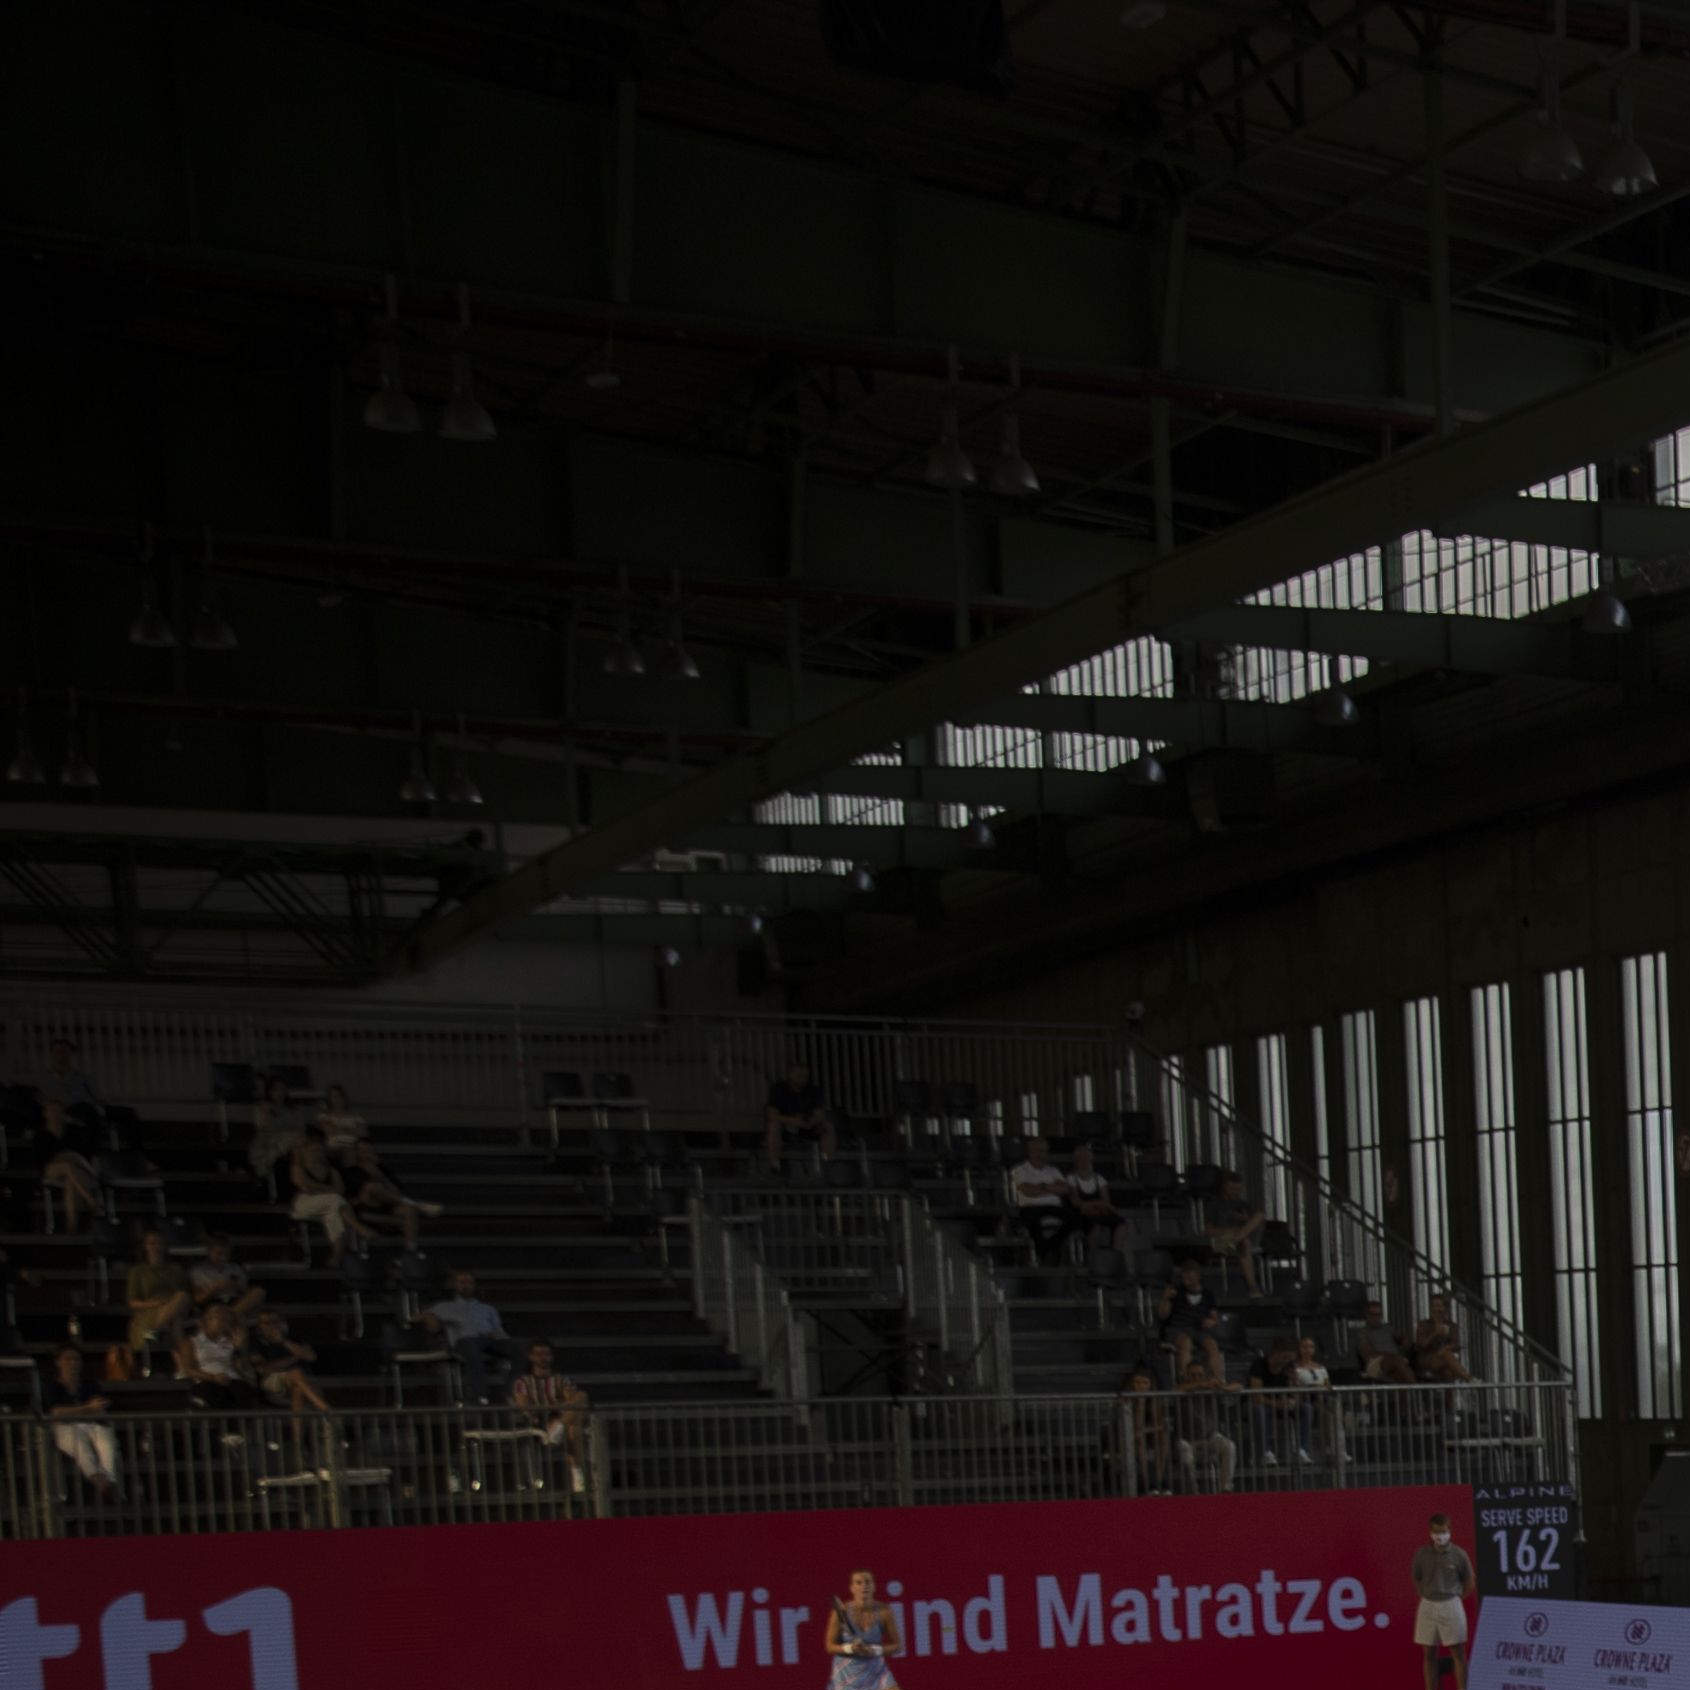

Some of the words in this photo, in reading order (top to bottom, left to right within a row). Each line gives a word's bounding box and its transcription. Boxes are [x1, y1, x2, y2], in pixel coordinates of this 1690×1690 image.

[1476, 1485, 1574, 1500] ALPINE
[1480, 1506, 1523, 1528] SERVE
[1525, 1505, 1568, 1527] SPEED
[1492, 1526, 1561, 1574] 162
[1505, 1573, 1550, 1592] KM/H
[667, 1587, 811, 1671] Wir
[885, 1573, 1008, 1658] ind
[1035, 1569, 1391, 1649] Matratze.
[1495, 1640, 1535, 1663] CROWNE
[1536, 1644, 1566, 1664] PLAZA
[1594, 1648, 1636, 1672] CROWNE
[1638, 1652, 1672, 1674] PLAZA
